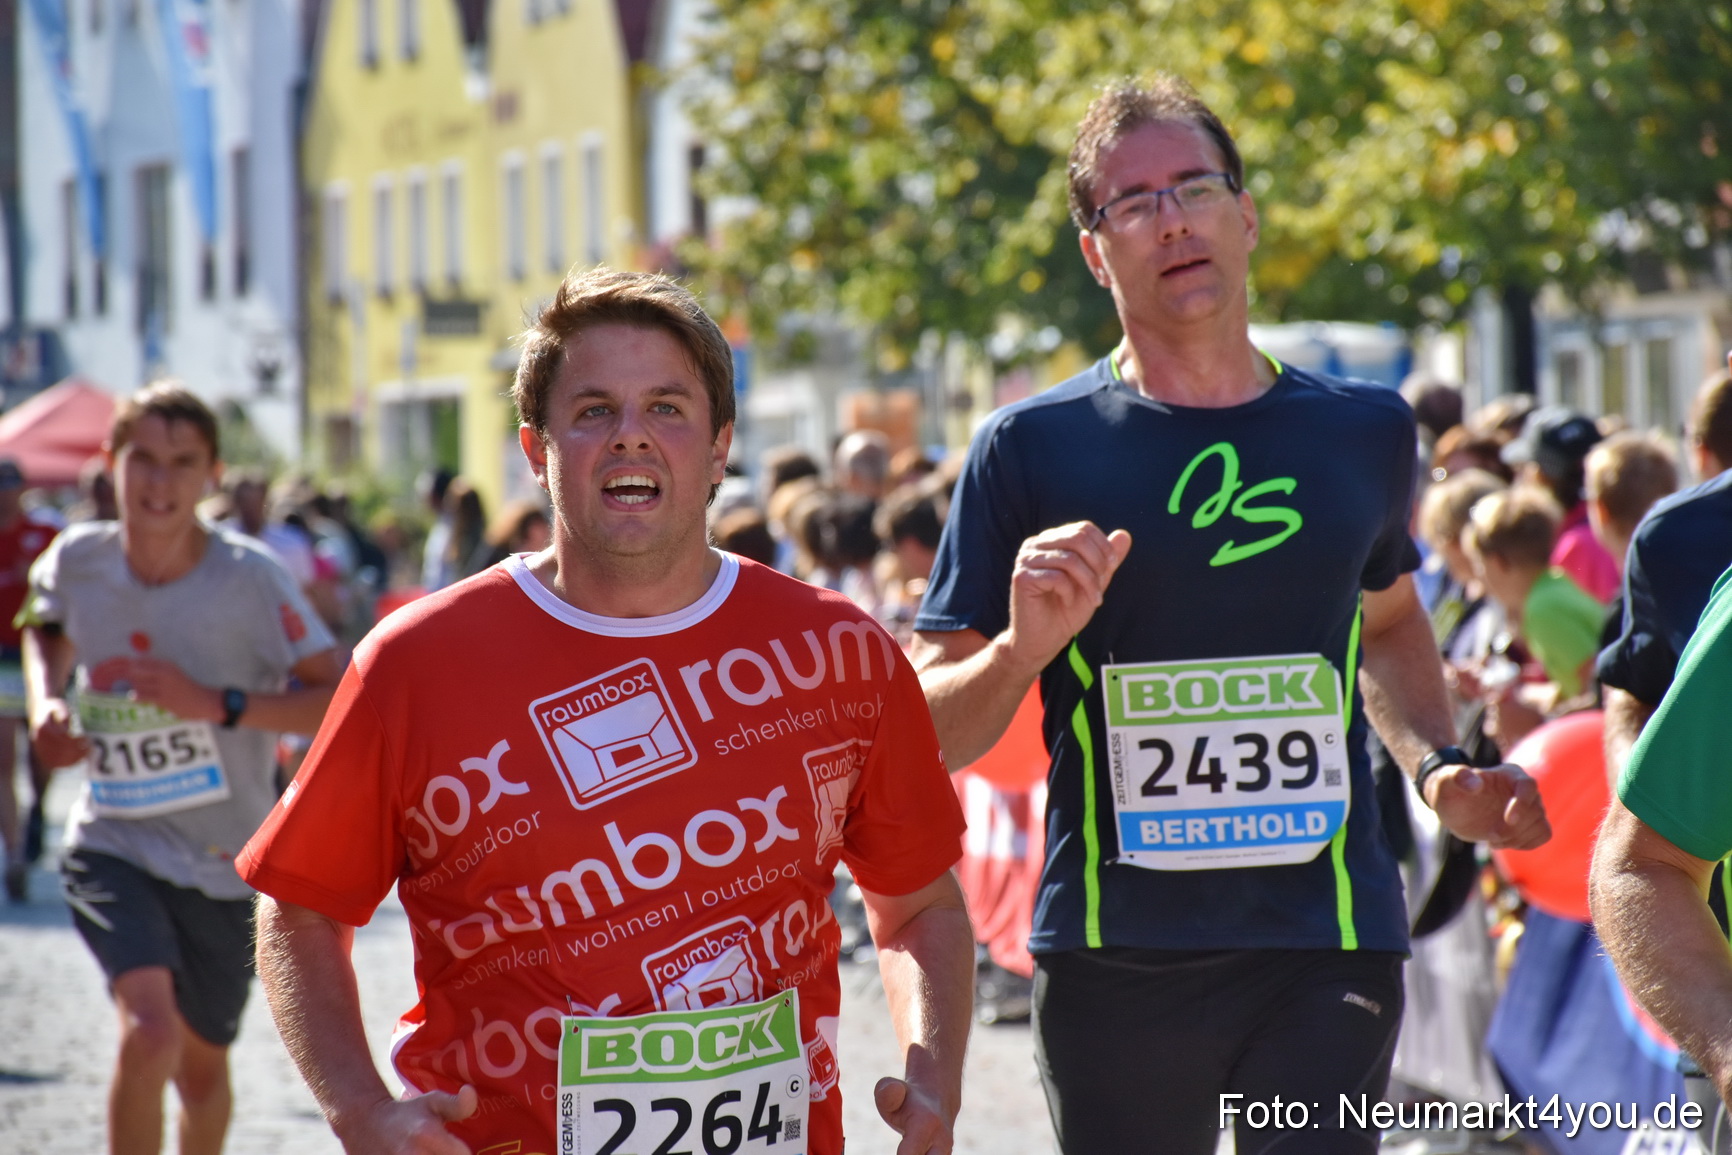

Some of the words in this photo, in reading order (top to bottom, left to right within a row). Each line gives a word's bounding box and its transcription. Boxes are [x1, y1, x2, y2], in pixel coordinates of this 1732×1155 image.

[542, 672, 653, 727] raumbox
[1127, 672, 1313, 712] BOCK
[93, 729, 196, 776] 2165
[714, 707, 828, 756] schenken
[1138, 730, 1319, 797] 2439
[455, 810, 541, 873] outdoor
[1140, 810, 1328, 845] BERTHOLD
[567, 903, 679, 957] wohnen
[701, 858, 801, 907] outdoor
[653, 928, 749, 985] raumbox
[584, 1009, 780, 1072] BOCK
[591, 1082, 783, 1155] 2264
